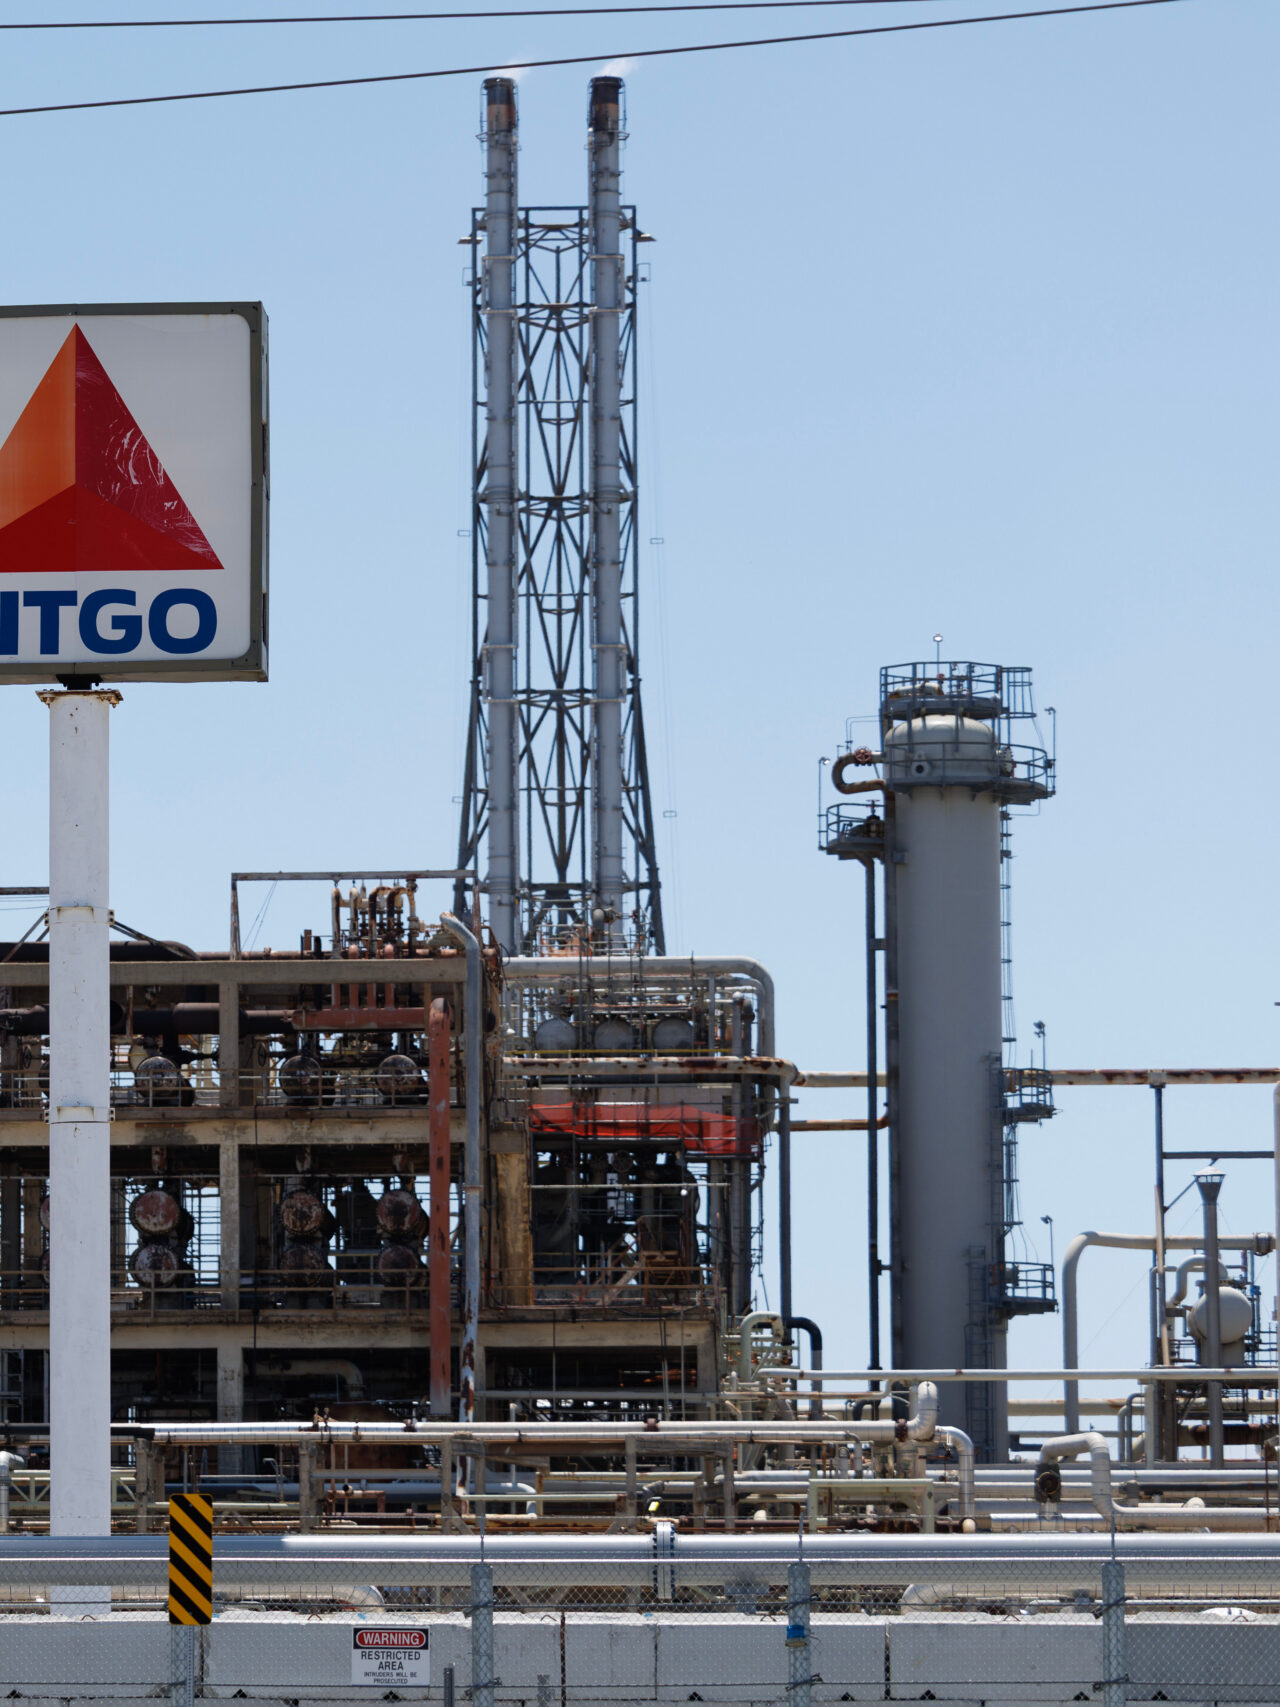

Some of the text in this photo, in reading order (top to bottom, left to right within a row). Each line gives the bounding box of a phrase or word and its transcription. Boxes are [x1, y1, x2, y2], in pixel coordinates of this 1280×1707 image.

[363, 1632, 420, 1645] WARNING
[361, 1650, 421, 1661] RESTRICTED
[378, 1661, 404, 1671] AREA
